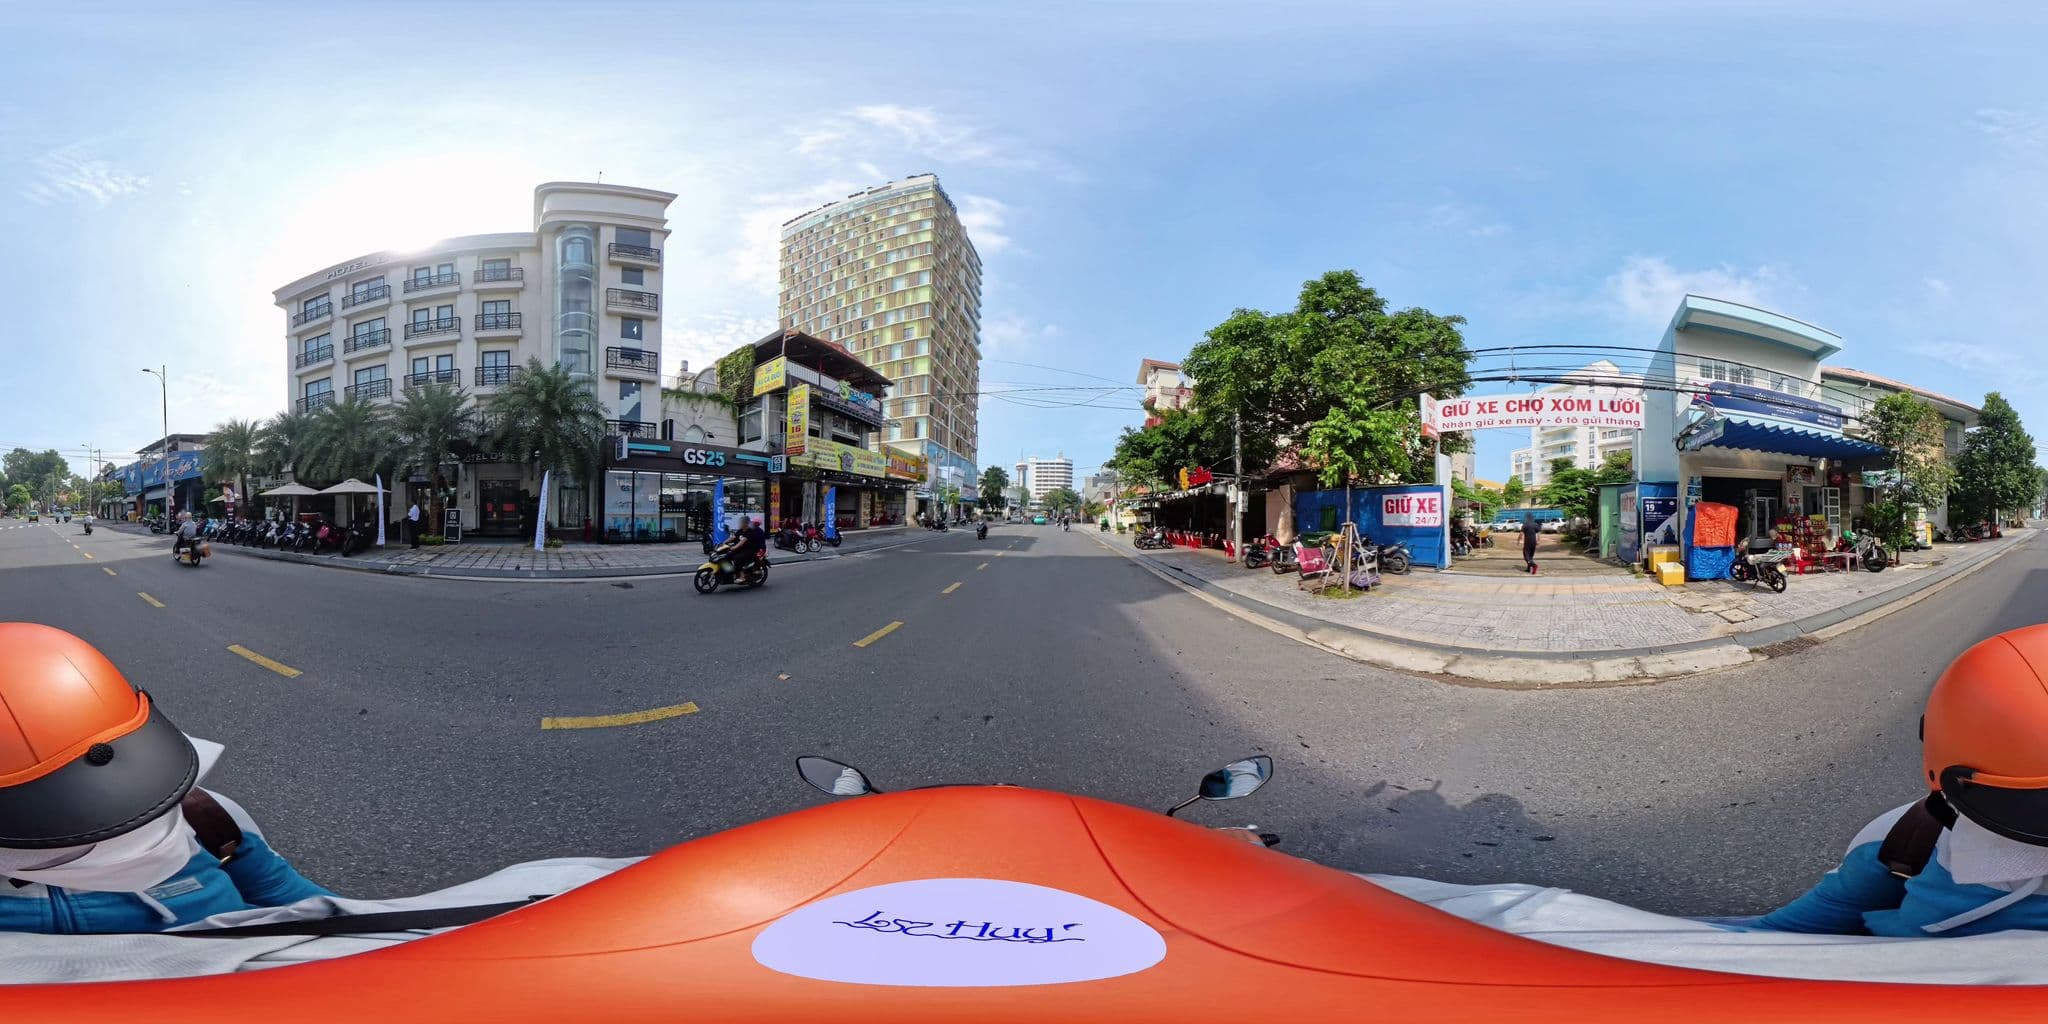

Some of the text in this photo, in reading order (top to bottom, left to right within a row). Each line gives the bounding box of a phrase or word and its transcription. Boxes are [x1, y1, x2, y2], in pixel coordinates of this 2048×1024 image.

[1442, 400, 1471, 417] GIỮ
[1476, 401, 1498, 414] XE
[1505, 397, 1544, 414] CHỢ
[1550, 395, 1591, 412] XÓM
[1599, 398, 1640, 414] LƯỚI
[1442, 420, 1471, 429] Nhận
[1516, 416, 1542, 425] máy
[1606, 416, 1640, 427] tháng
[684, 448, 725, 467] GS25
[1385, 495, 1437, 514] GIỮ XE
[1415, 516, 1438, 524] 24/7
